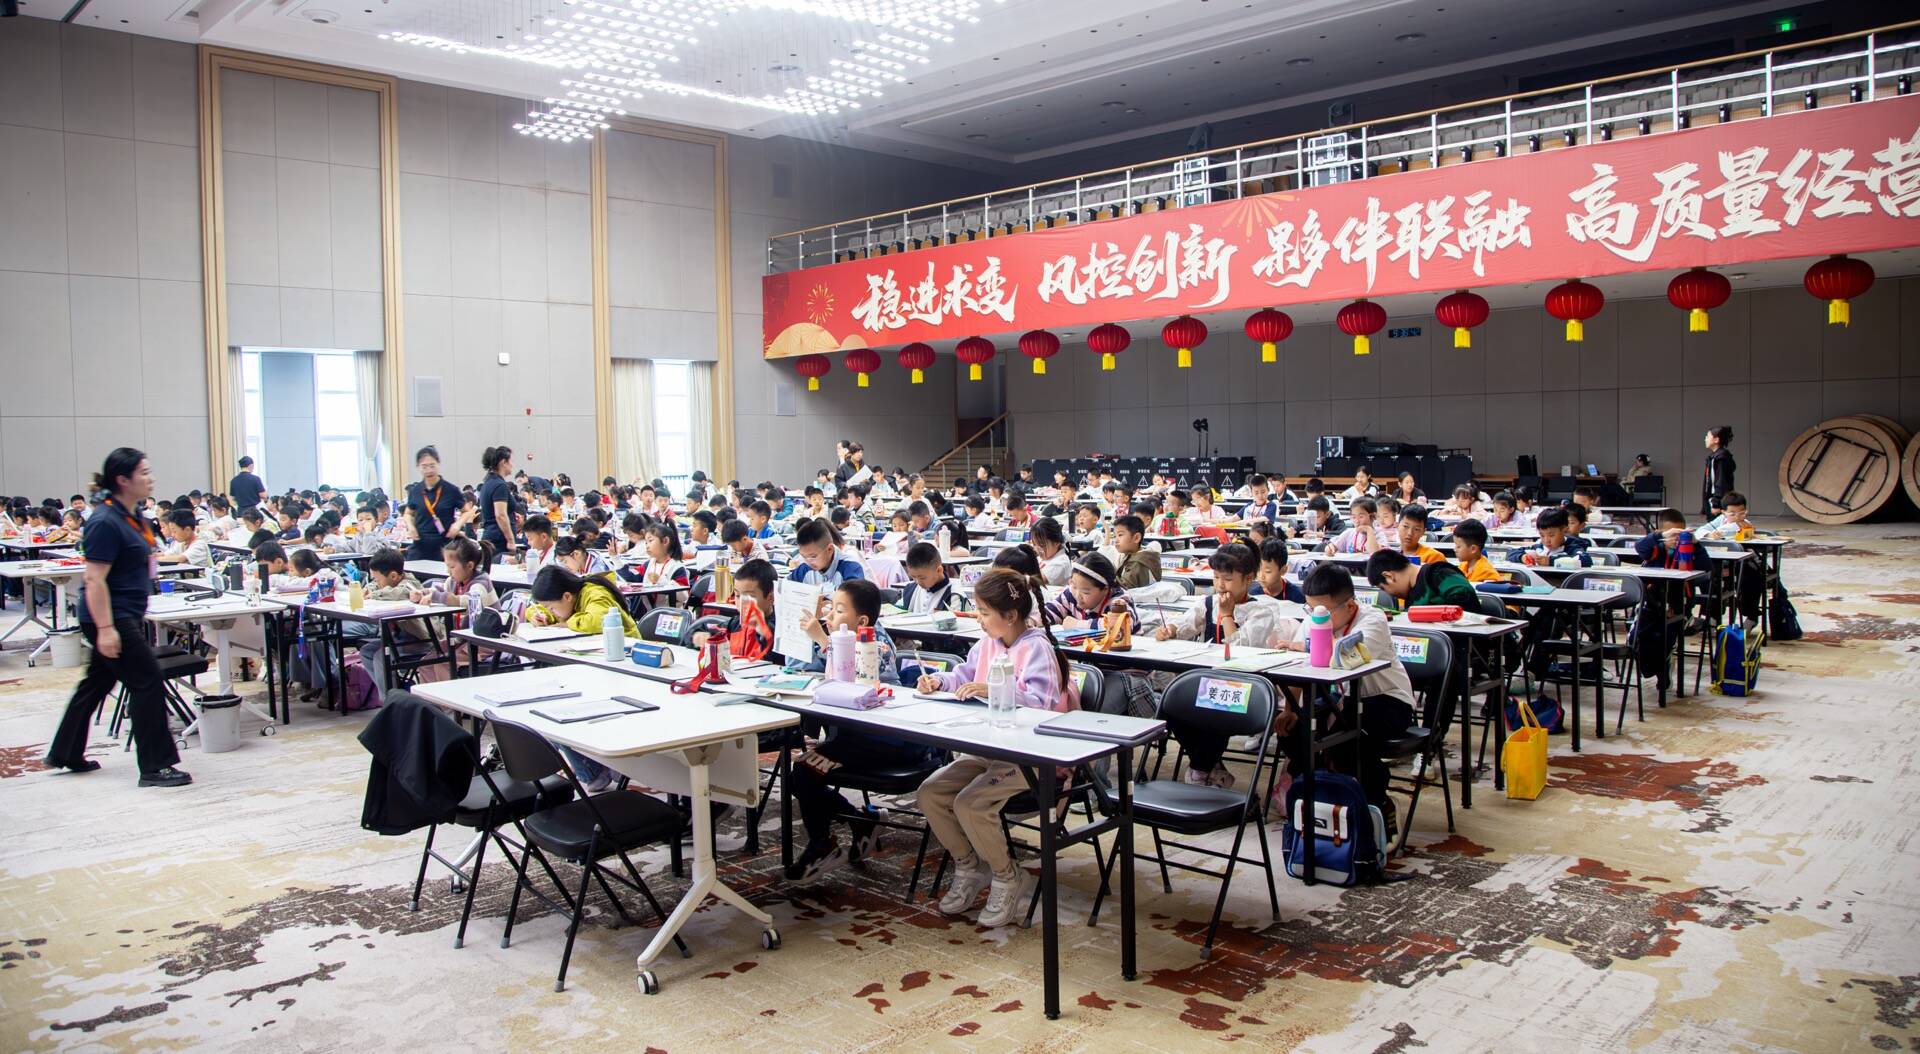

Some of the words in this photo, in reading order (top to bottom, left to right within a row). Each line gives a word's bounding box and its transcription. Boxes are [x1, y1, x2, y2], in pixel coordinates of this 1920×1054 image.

[850, 256, 1018, 333] 稳进求变
[1037, 223, 1239, 309] 风控创新
[1208, 686, 1243, 703] 姜亦宸
